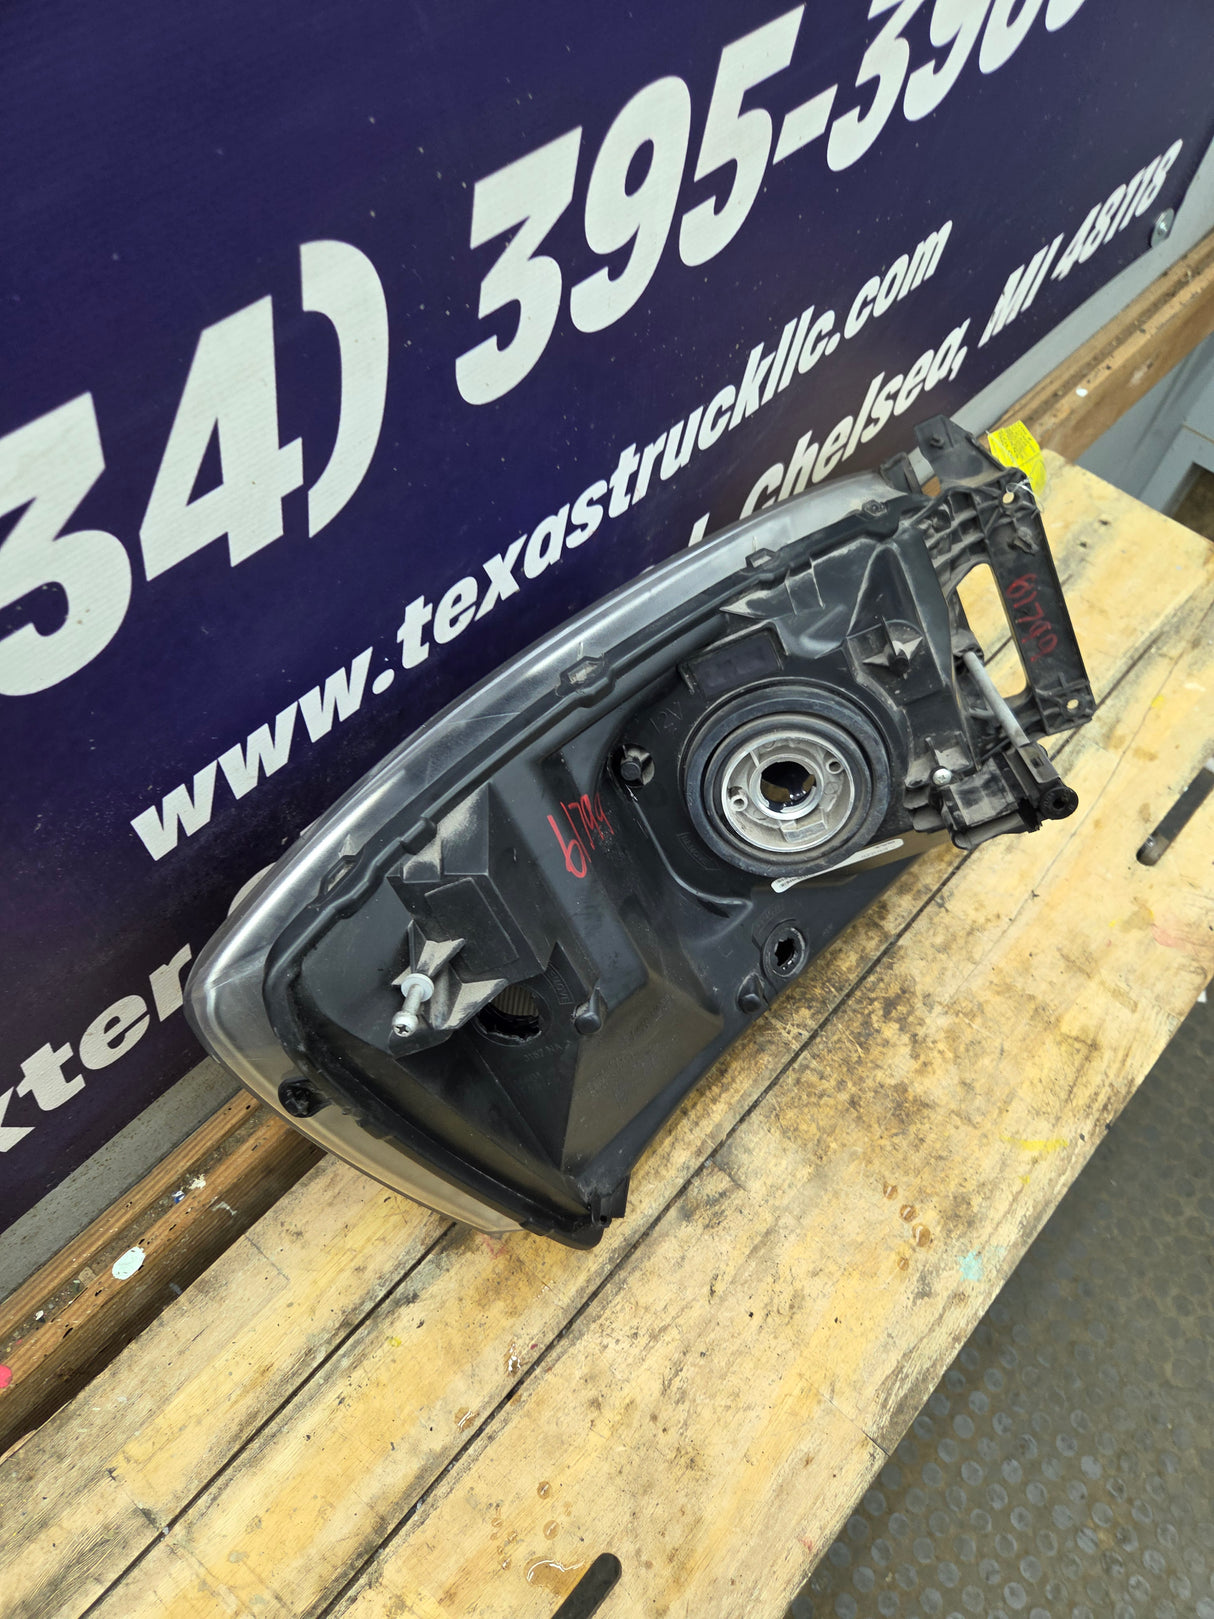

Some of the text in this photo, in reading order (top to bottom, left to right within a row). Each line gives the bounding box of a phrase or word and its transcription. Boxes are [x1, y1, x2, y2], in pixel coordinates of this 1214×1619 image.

[979, 232, 1064, 348] MI
[1051, 138, 1184, 281] 48118
[130, 220, 953, 861] www.texastruckllc.com
